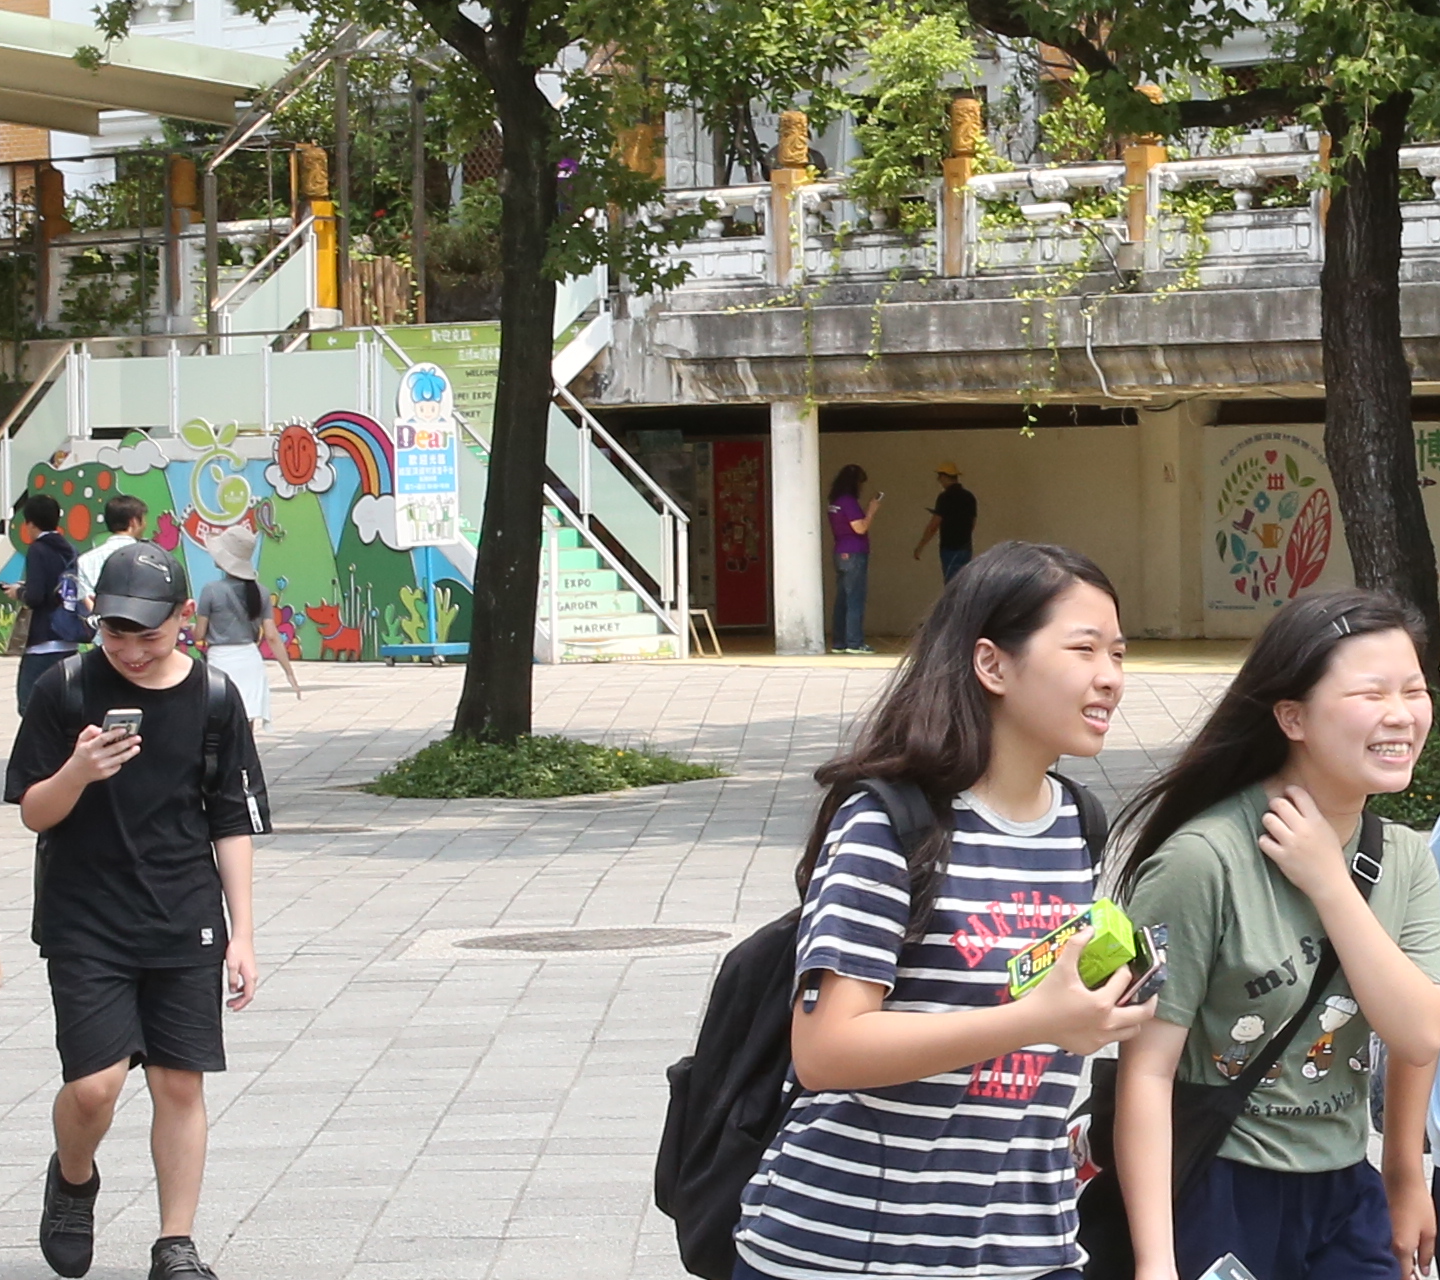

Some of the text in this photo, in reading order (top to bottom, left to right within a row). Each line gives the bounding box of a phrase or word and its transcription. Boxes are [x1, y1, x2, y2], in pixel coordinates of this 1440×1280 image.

[472, 391, 493, 400] EXPO
[564, 578, 591, 589] EXPO
[573, 622, 621, 634] MARKET
[948, 900, 1013, 969] BAR
[1244, 955, 1298, 1000] my
[1265, 1100, 1301, 1118] two
[1305, 1099, 1320, 1116] of
